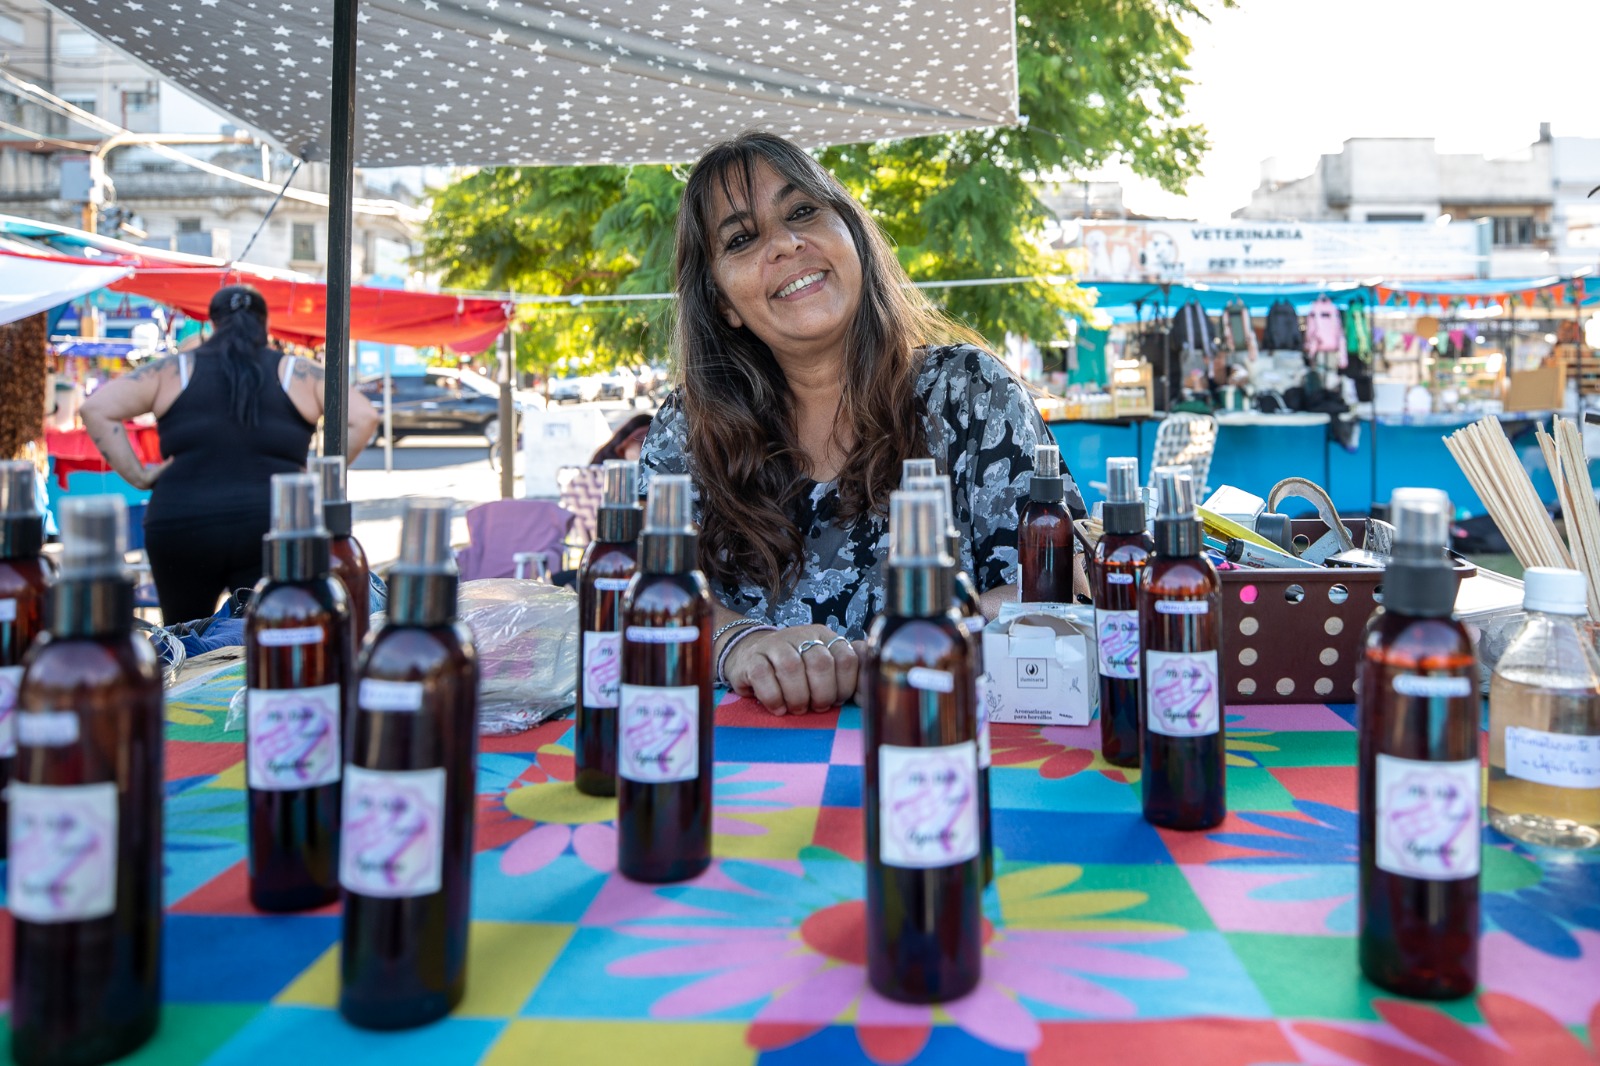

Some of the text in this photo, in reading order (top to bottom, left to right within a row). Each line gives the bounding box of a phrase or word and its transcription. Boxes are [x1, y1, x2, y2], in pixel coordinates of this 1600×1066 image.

[1191, 229, 1303, 240] VETERINARIA
[1243, 243, 1252, 254] Y
[1208, 258, 1285, 269] PET SHOP
